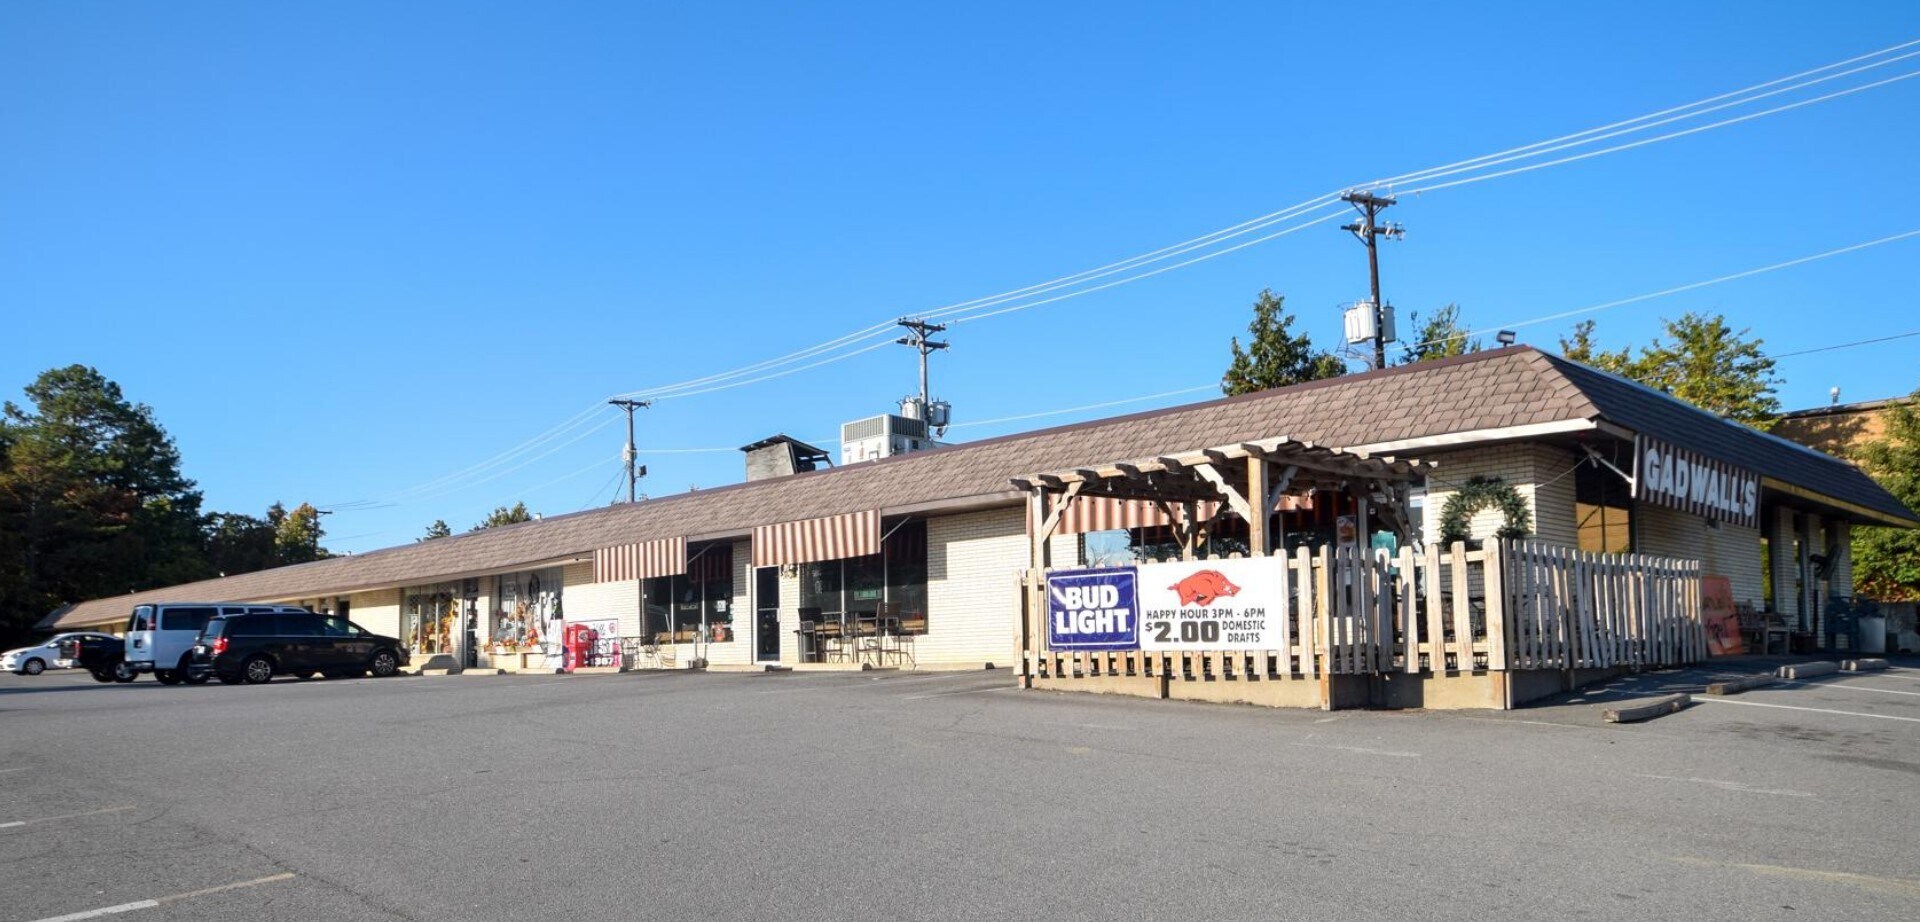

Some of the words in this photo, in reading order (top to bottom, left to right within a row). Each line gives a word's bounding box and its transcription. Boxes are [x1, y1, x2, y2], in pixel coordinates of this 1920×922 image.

[1644, 448, 1756, 516] GADWALL'S
[1064, 584, 1119, 610] BUD
[1146, 609, 1177, 619] HAPPY
[1180, 608, 1208, 619] HOUR
[1212, 608, 1233, 618] 3PM
[1244, 607, 1265, 618] 6PM
[1145, 620, 1219, 642] $2.00
[1227, 632, 1260, 643] DRAFTS
